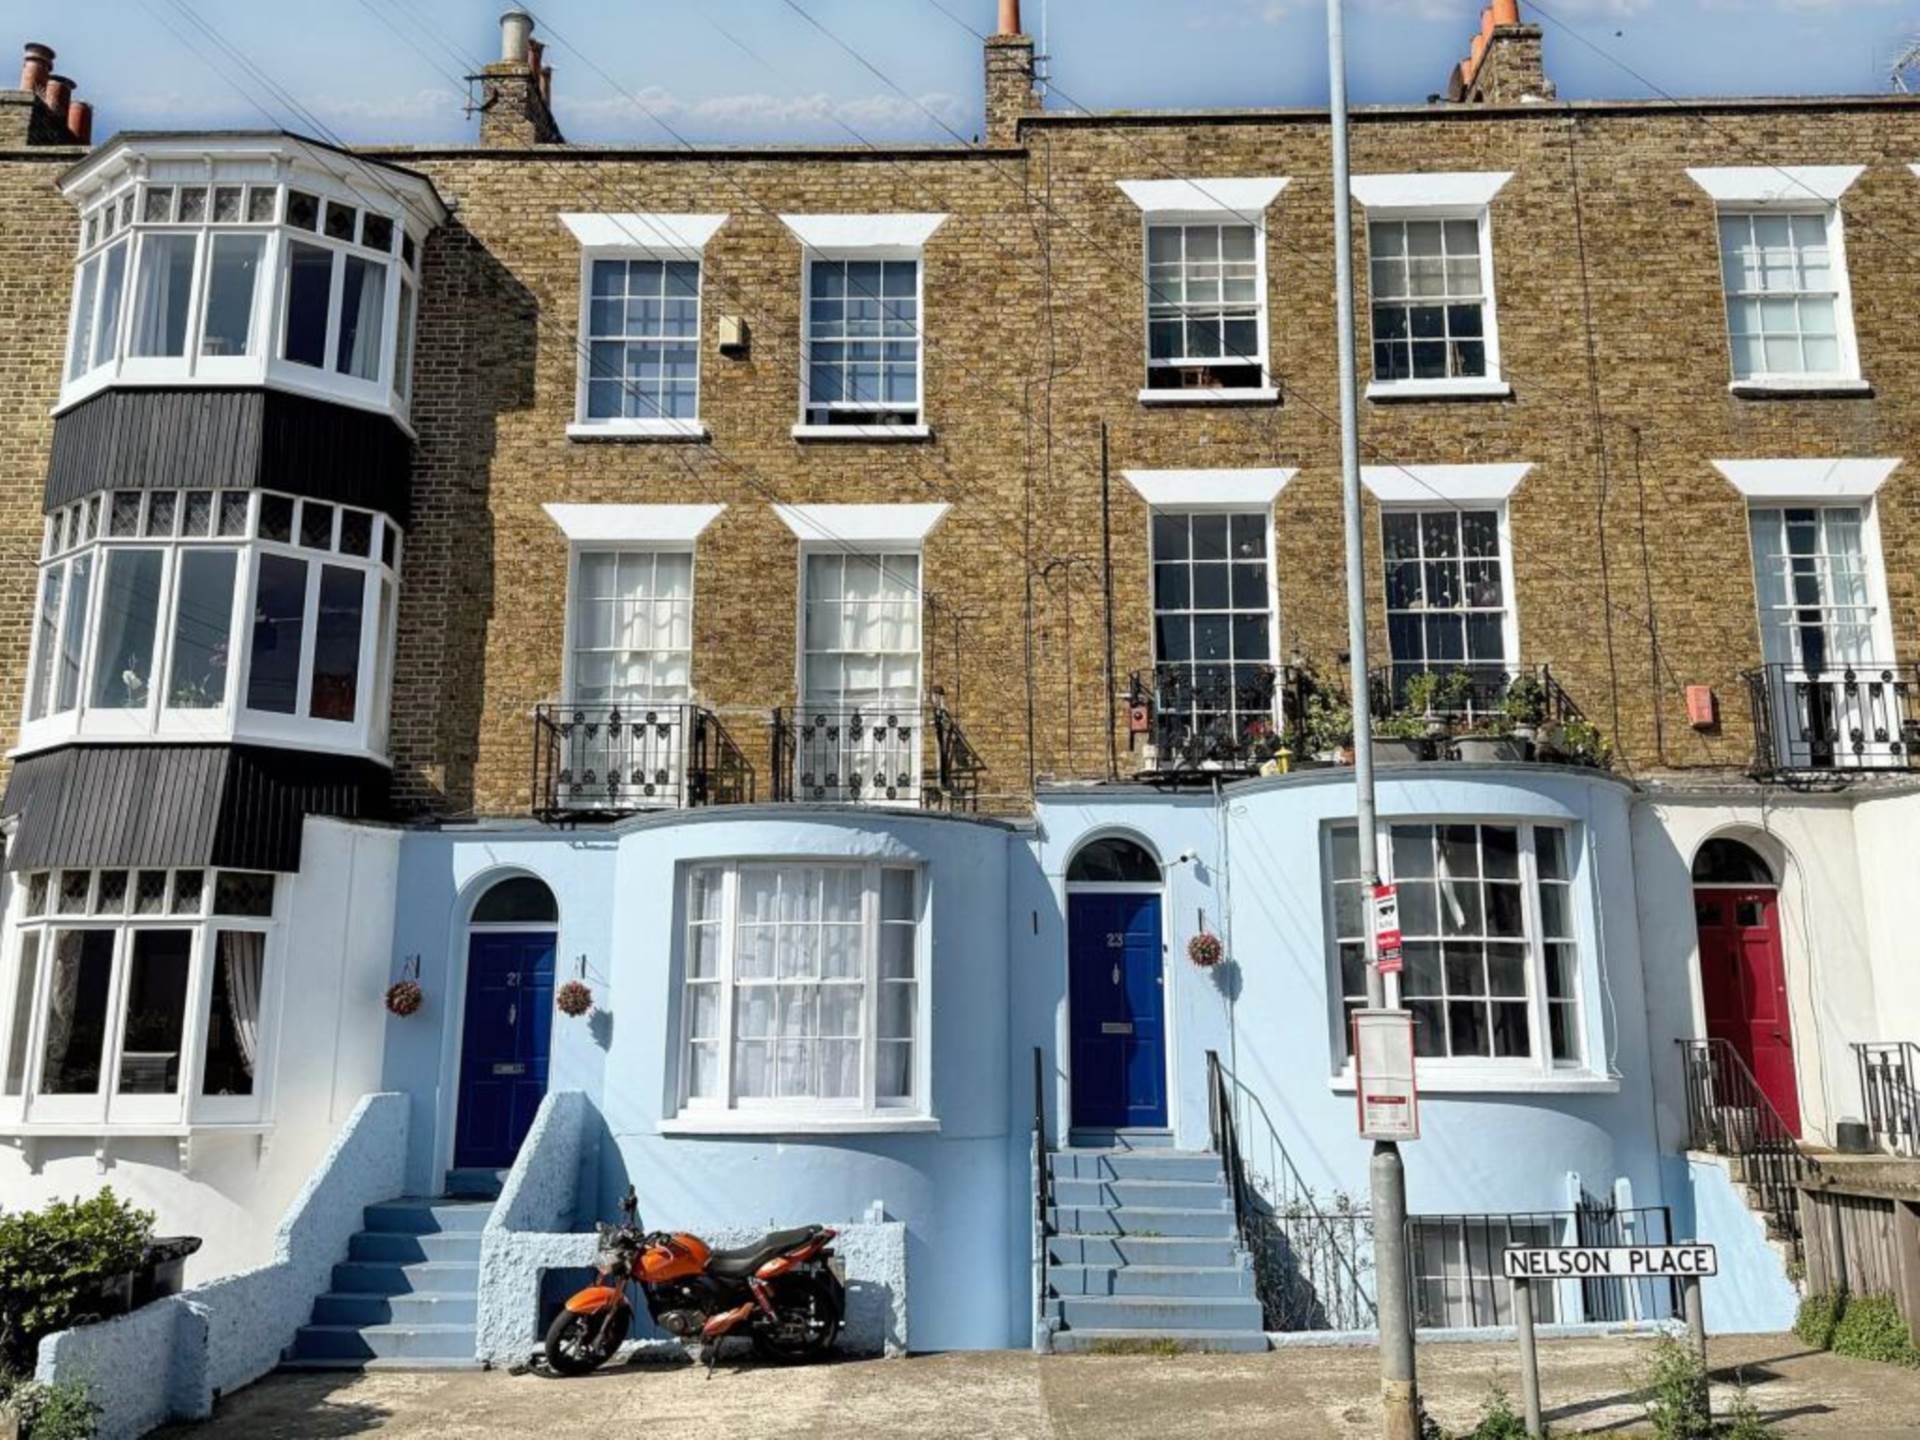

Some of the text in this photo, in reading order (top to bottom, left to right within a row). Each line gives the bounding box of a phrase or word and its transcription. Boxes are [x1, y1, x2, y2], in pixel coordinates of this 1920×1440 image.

[1106, 932, 1123, 947] 23
[506, 971, 521, 987] 21
[1510, 1250, 1708, 1274] NELSON PLACE
